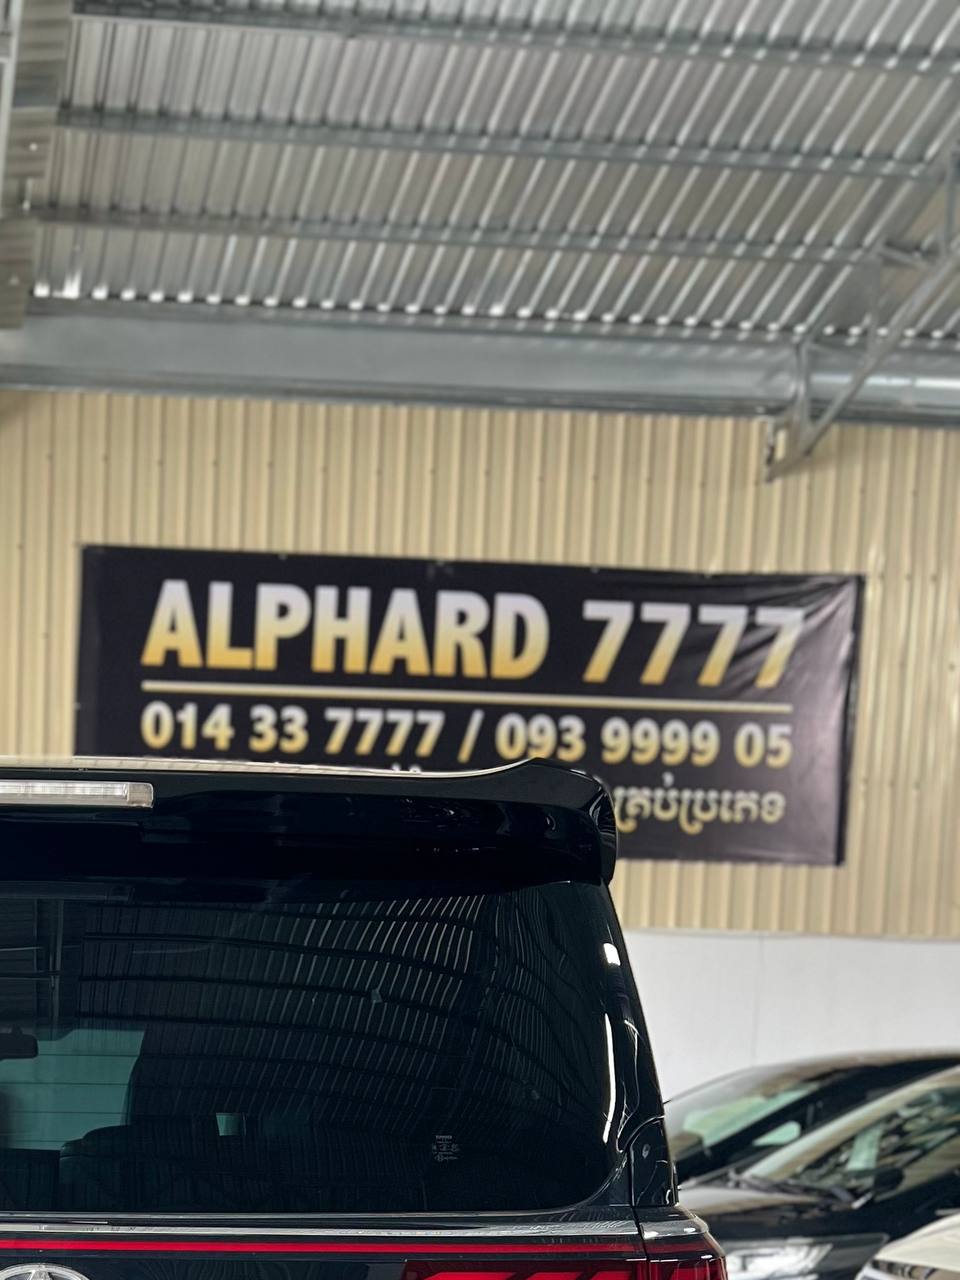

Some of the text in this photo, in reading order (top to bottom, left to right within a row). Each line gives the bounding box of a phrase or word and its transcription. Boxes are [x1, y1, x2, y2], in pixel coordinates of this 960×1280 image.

[141, 579, 808, 690] ALPHARD 7777
[140, 700, 793, 769] 014 33 7777 / 093 9999 05
